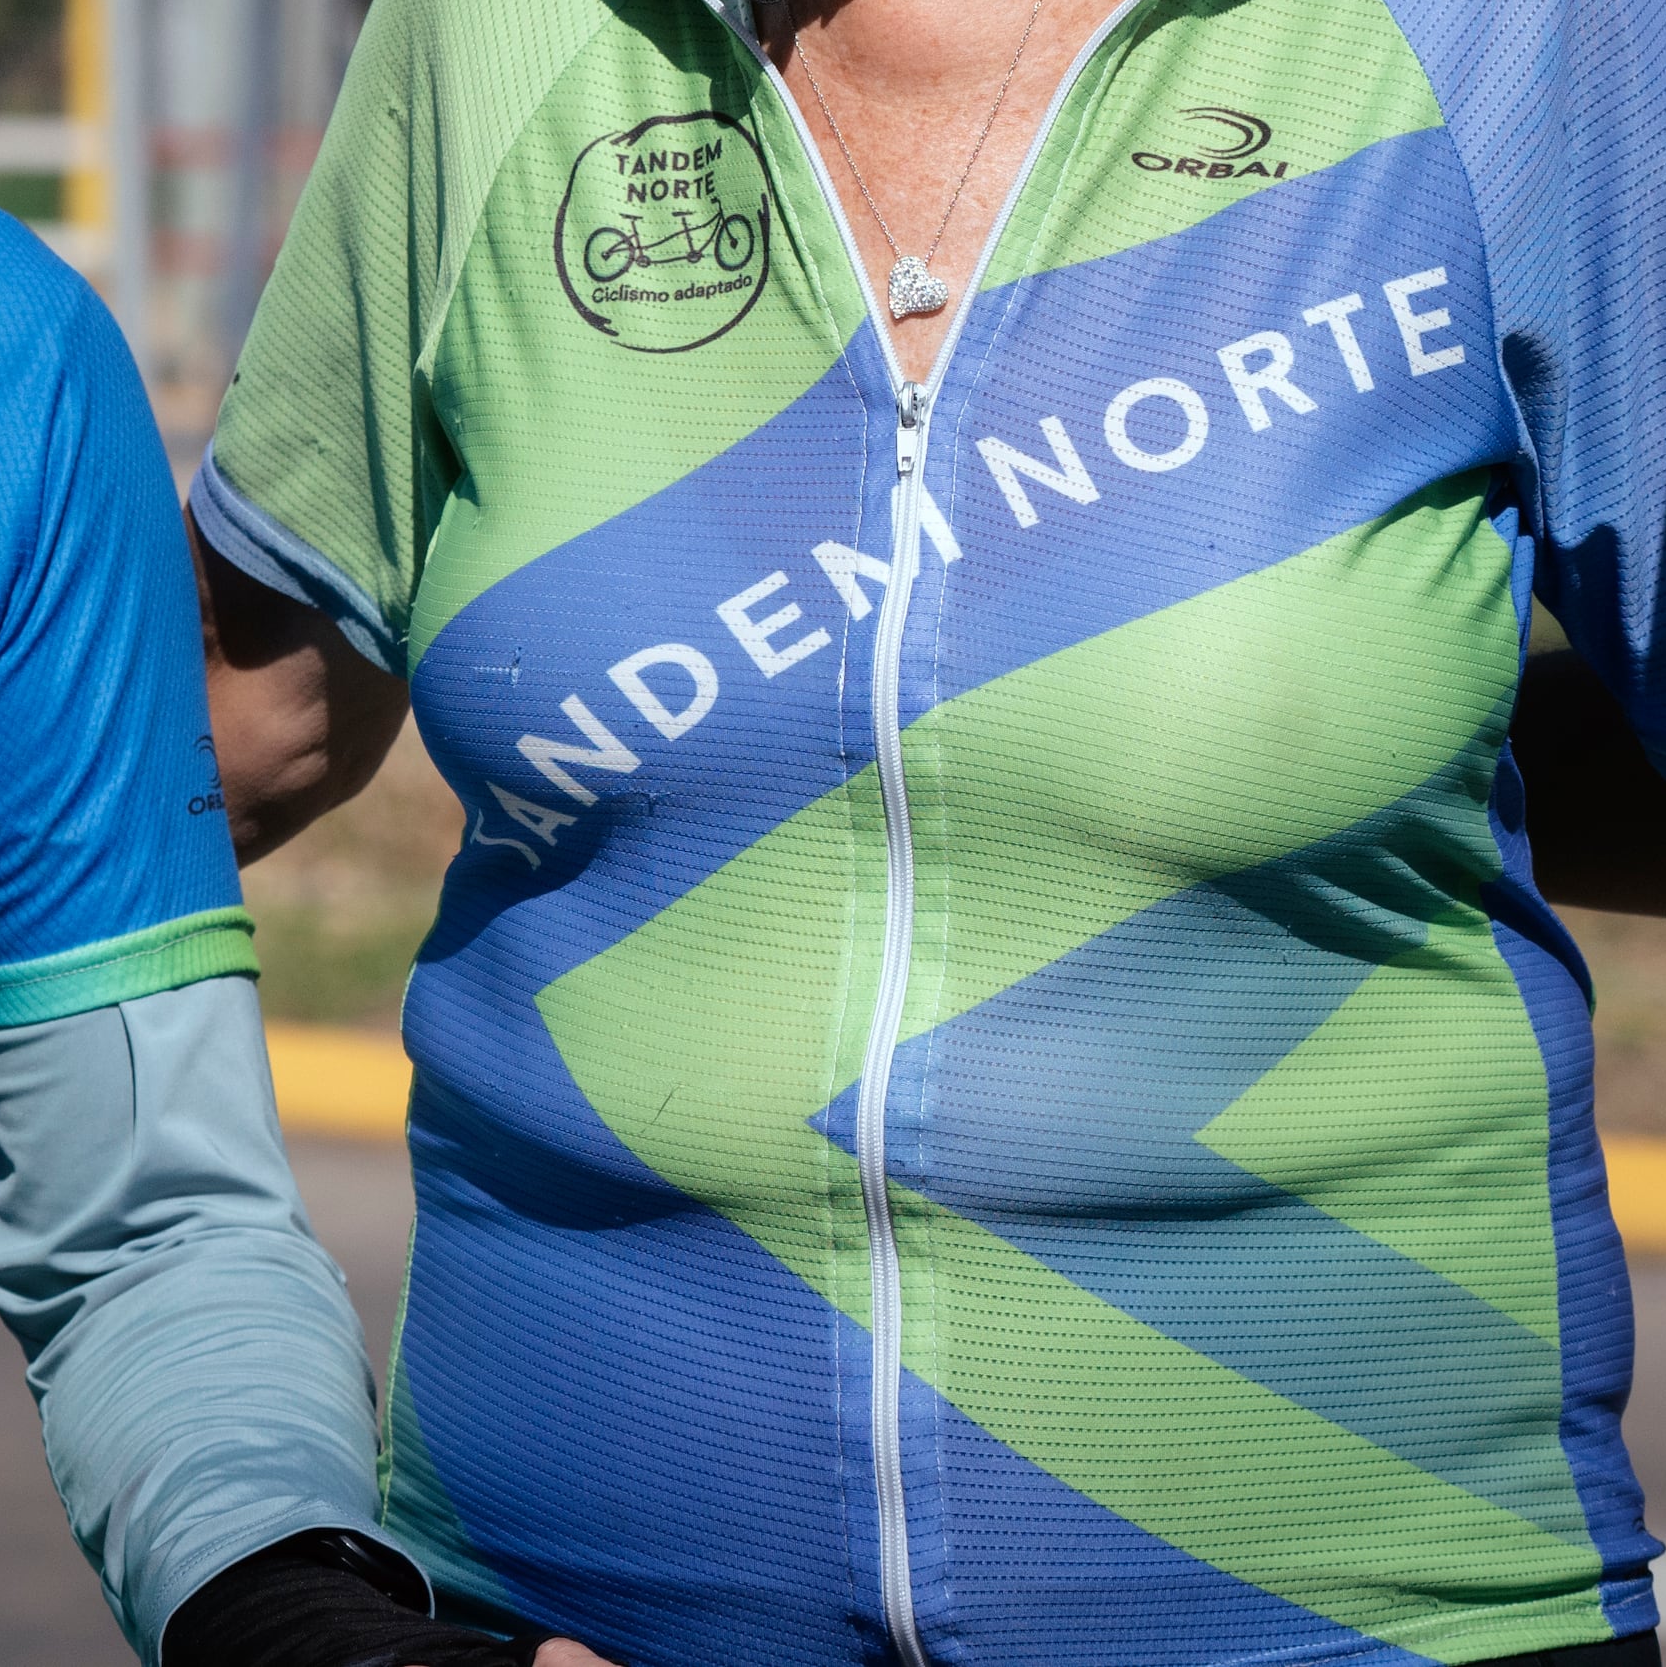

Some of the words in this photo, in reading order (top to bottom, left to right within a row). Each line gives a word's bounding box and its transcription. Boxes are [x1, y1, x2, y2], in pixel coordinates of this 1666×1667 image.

[616, 138, 723, 176] TANDEM
[1131, 151, 1290, 179] ORBAI
[627, 171, 716, 204] NORTE
[591, 284, 670, 304] Ciclismo
[674, 274, 753, 301] adaptado
[469, 481, 962, 871] TANDEM
[976, 265, 1466, 530] NORTE
